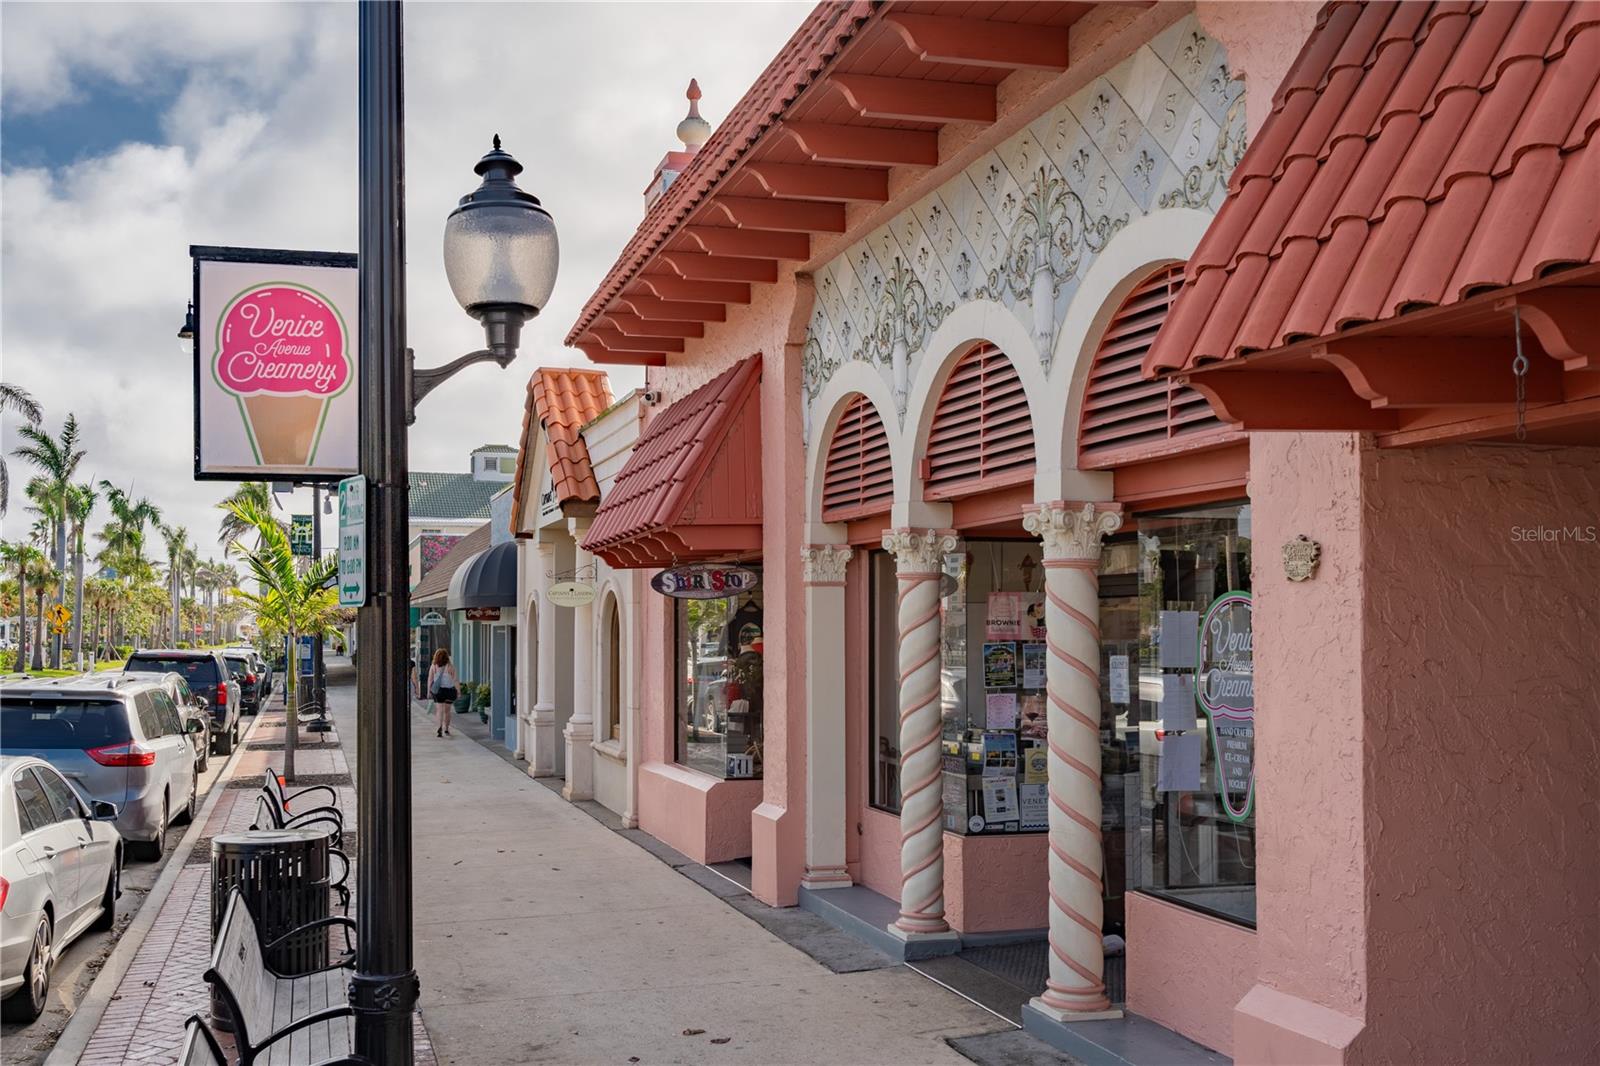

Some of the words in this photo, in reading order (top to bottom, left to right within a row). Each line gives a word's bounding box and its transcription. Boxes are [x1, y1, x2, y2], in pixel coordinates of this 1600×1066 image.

[240, 303, 324, 338] Venice
[254, 338, 312, 358] Avenue
[228, 351, 337, 392] Creamery
[985, 619, 1021, 627] BROWNIE
[1232, 767, 1243, 777] AND
